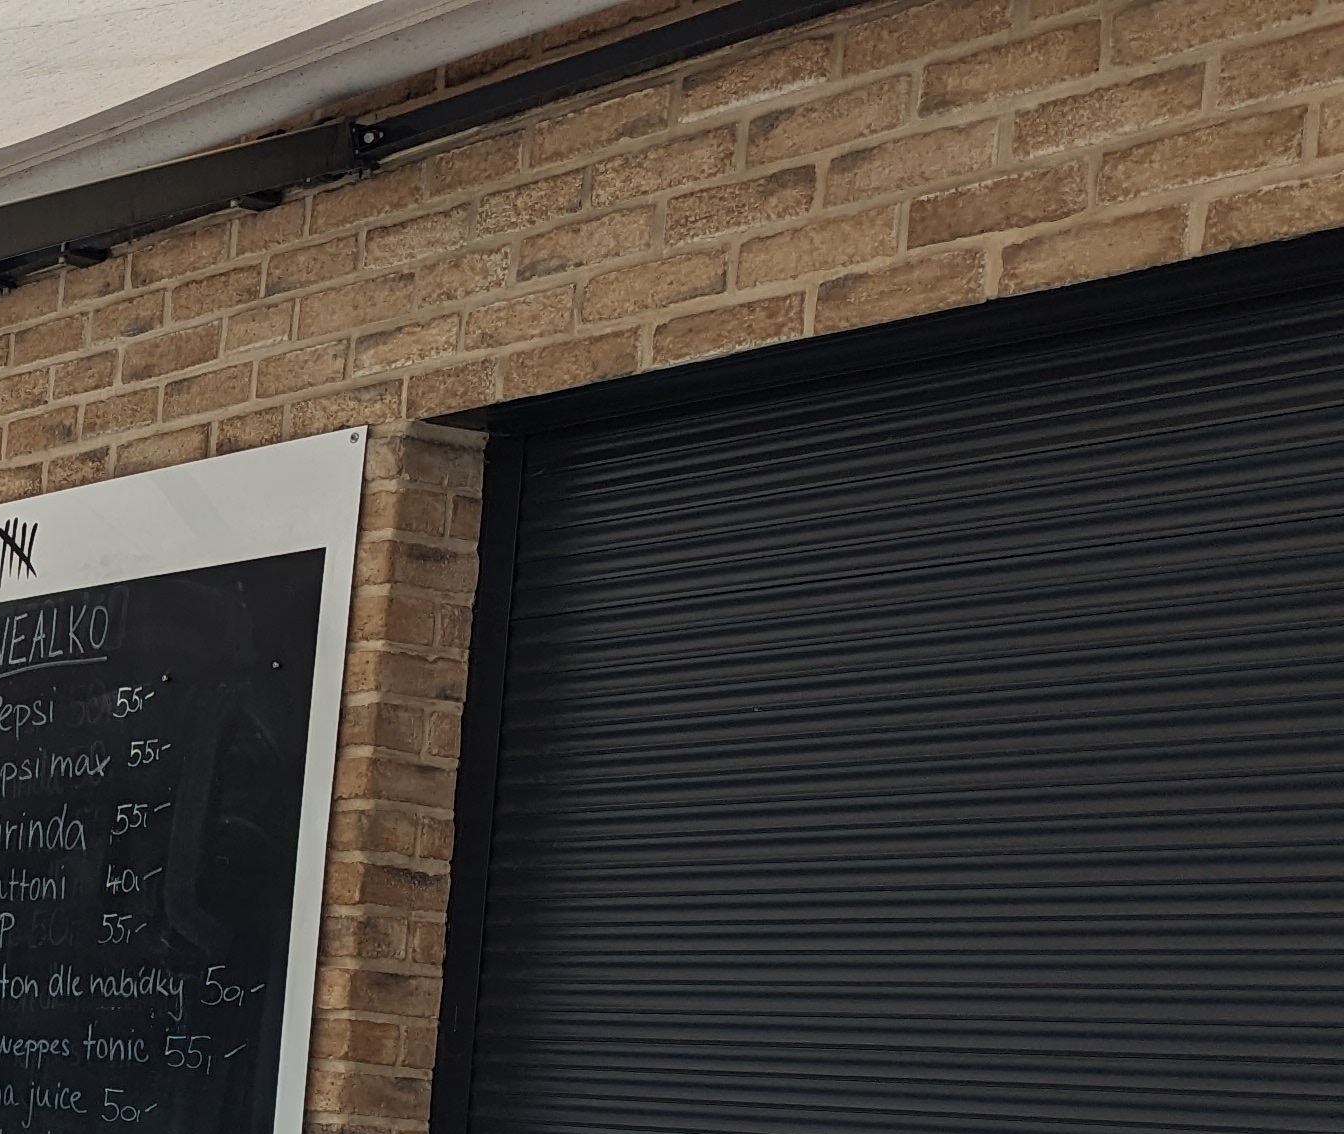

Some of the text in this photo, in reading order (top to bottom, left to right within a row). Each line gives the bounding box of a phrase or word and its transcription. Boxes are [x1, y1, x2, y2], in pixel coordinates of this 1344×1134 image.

[50, 753, 111, 778] max
[48, 964, 84, 997] dle
[83, 1024, 150, 1064] tonic
[21, 1081, 88, 1128] juice
